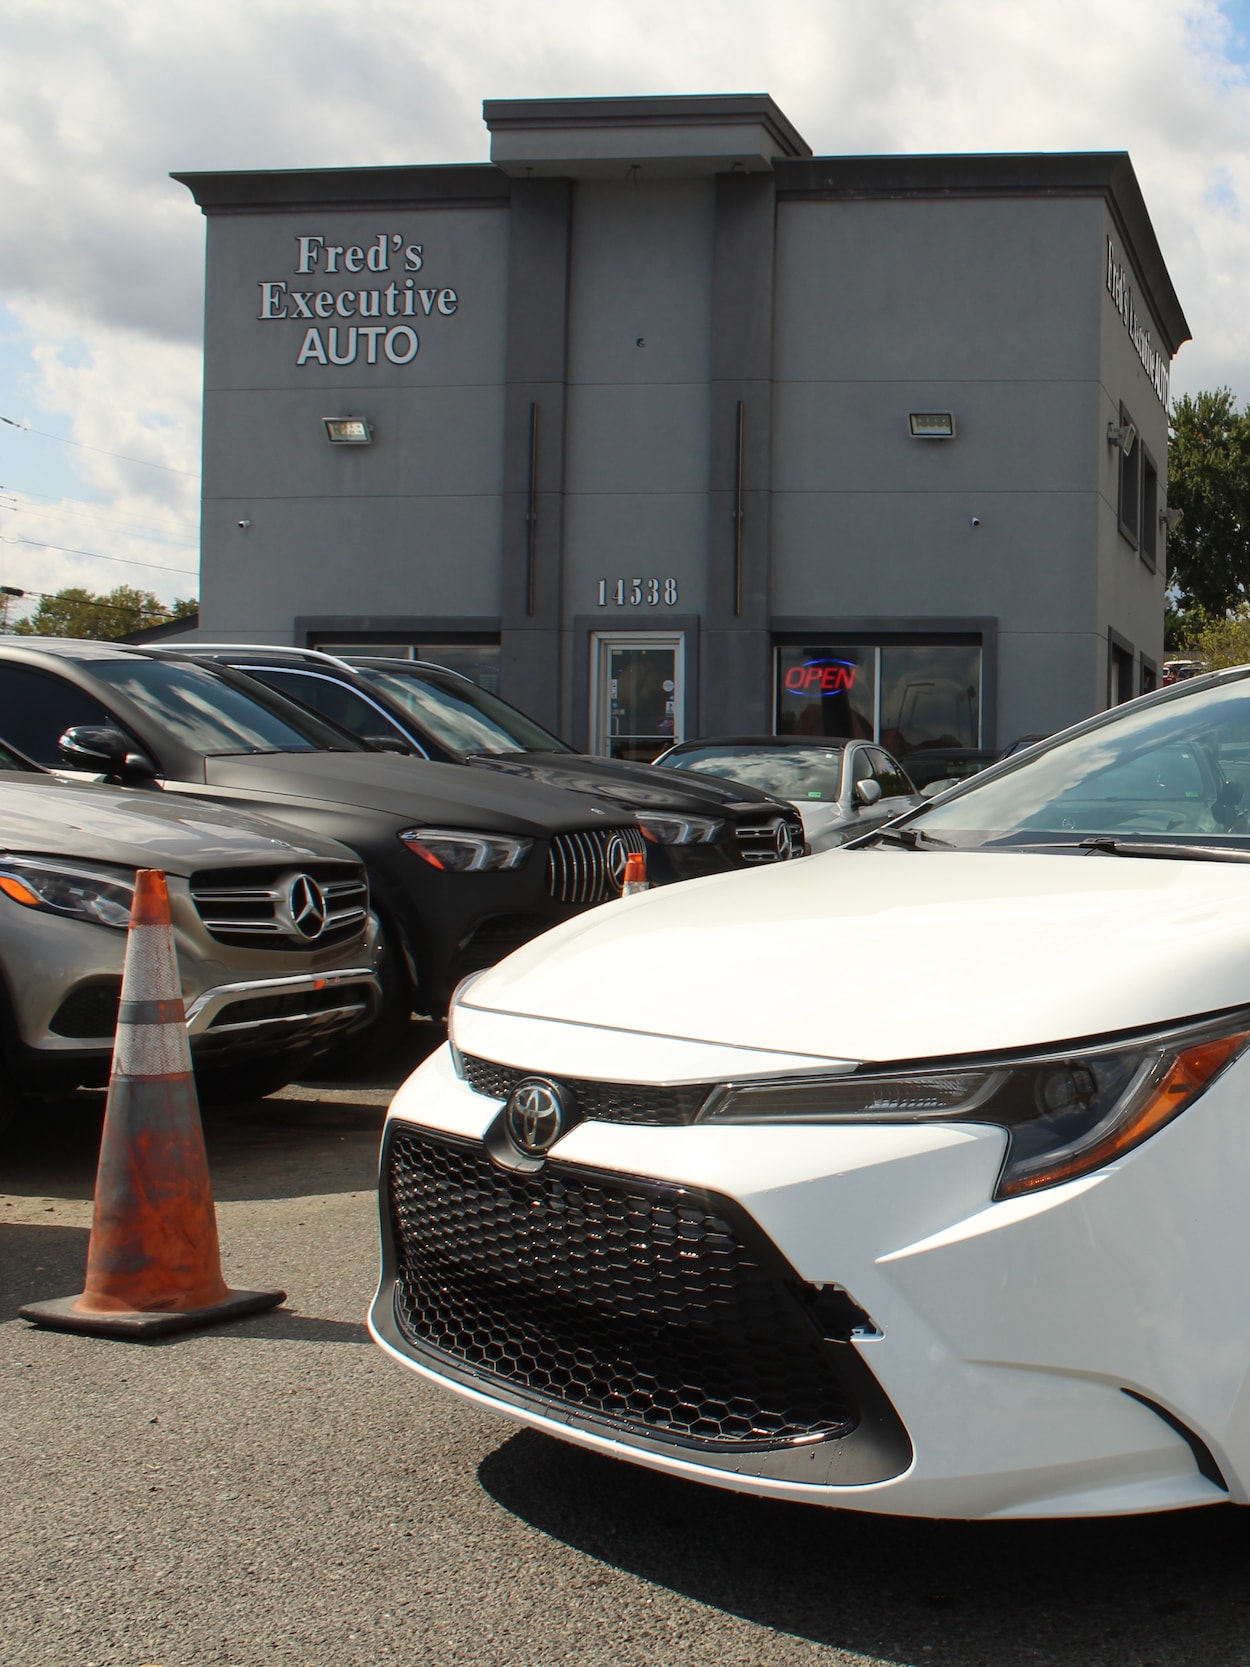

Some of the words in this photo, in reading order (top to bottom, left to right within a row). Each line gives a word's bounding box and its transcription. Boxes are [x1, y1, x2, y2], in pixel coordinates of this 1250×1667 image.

[295, 233, 424, 275] Fred's
[257, 278, 458, 320] Executive
[296, 325, 420, 366] AUTO
[597, 577, 679, 606] 14538
[784, 665, 858, 690] OPEN
